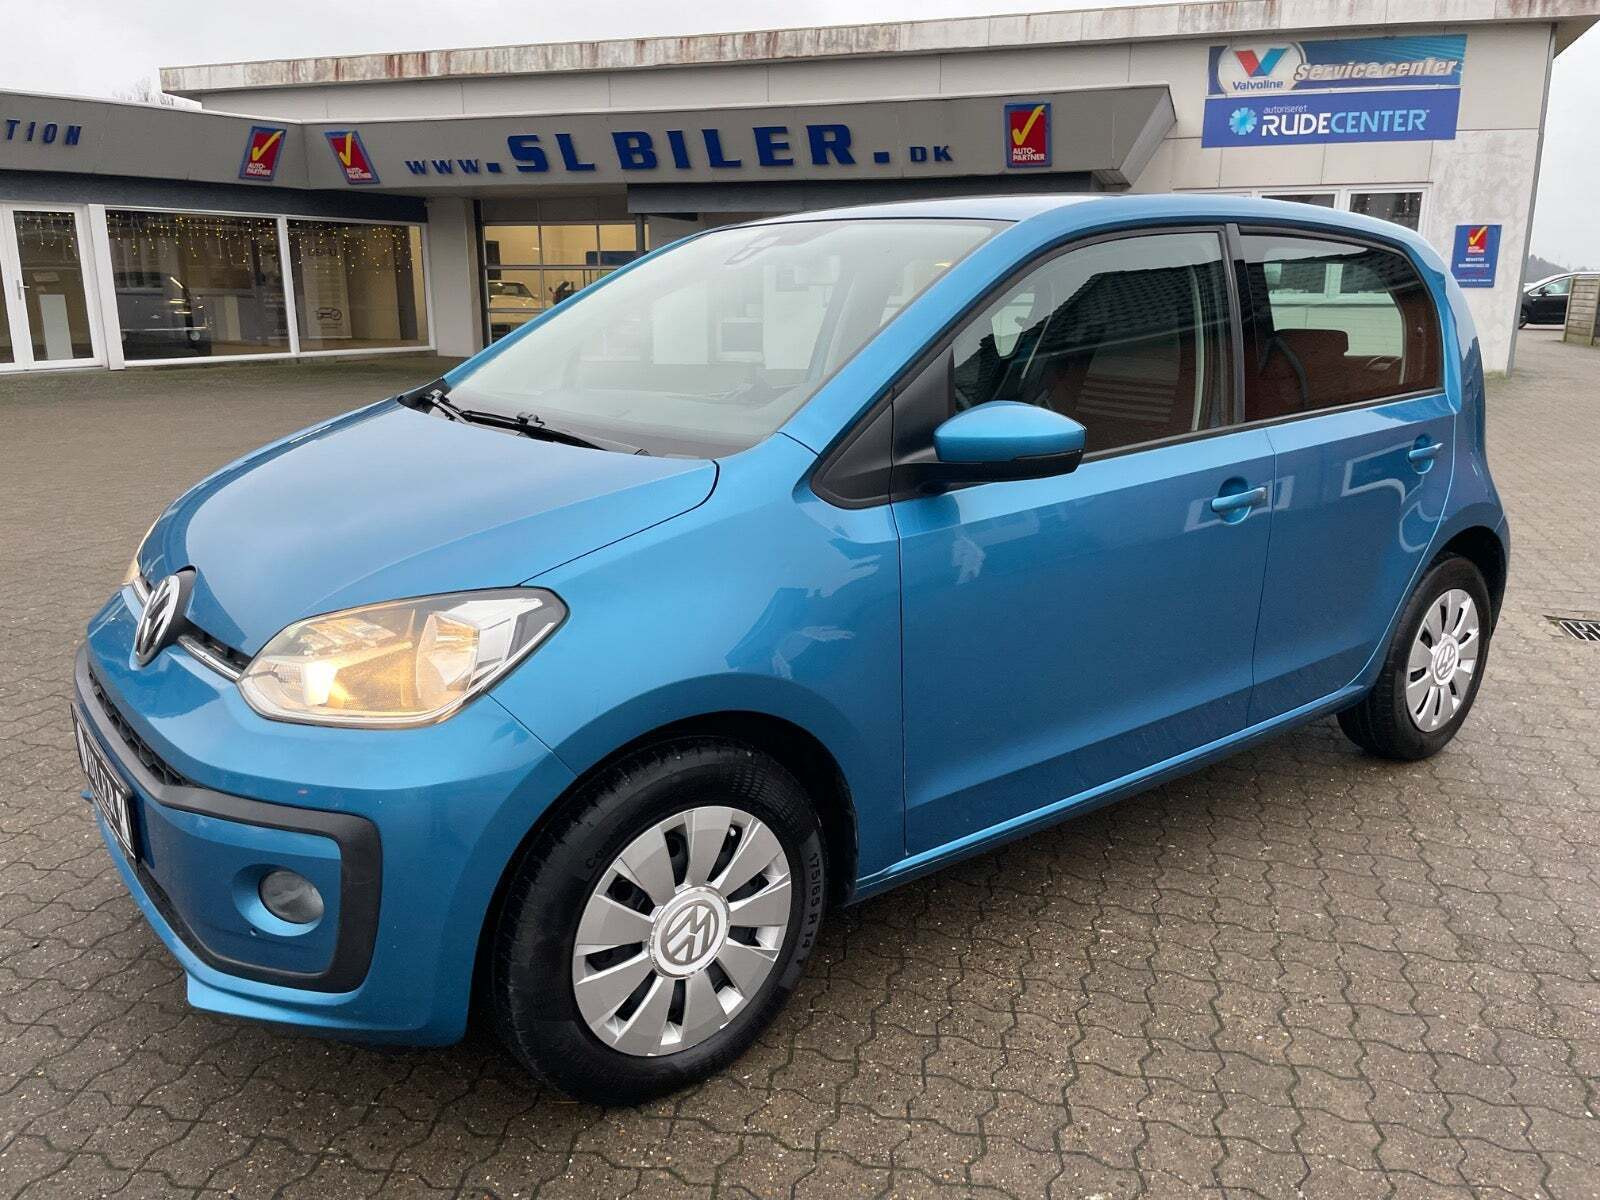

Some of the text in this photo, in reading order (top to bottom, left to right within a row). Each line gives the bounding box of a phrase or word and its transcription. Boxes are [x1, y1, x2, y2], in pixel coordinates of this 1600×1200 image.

[1232, 80, 1283, 90] Valvoline
[1263, 105, 1307, 114] autoriseret
[6, 119, 82, 145] TION
[1262, 110, 1426, 136] RUDECENTER
[808, 852, 821, 907] 175/65
